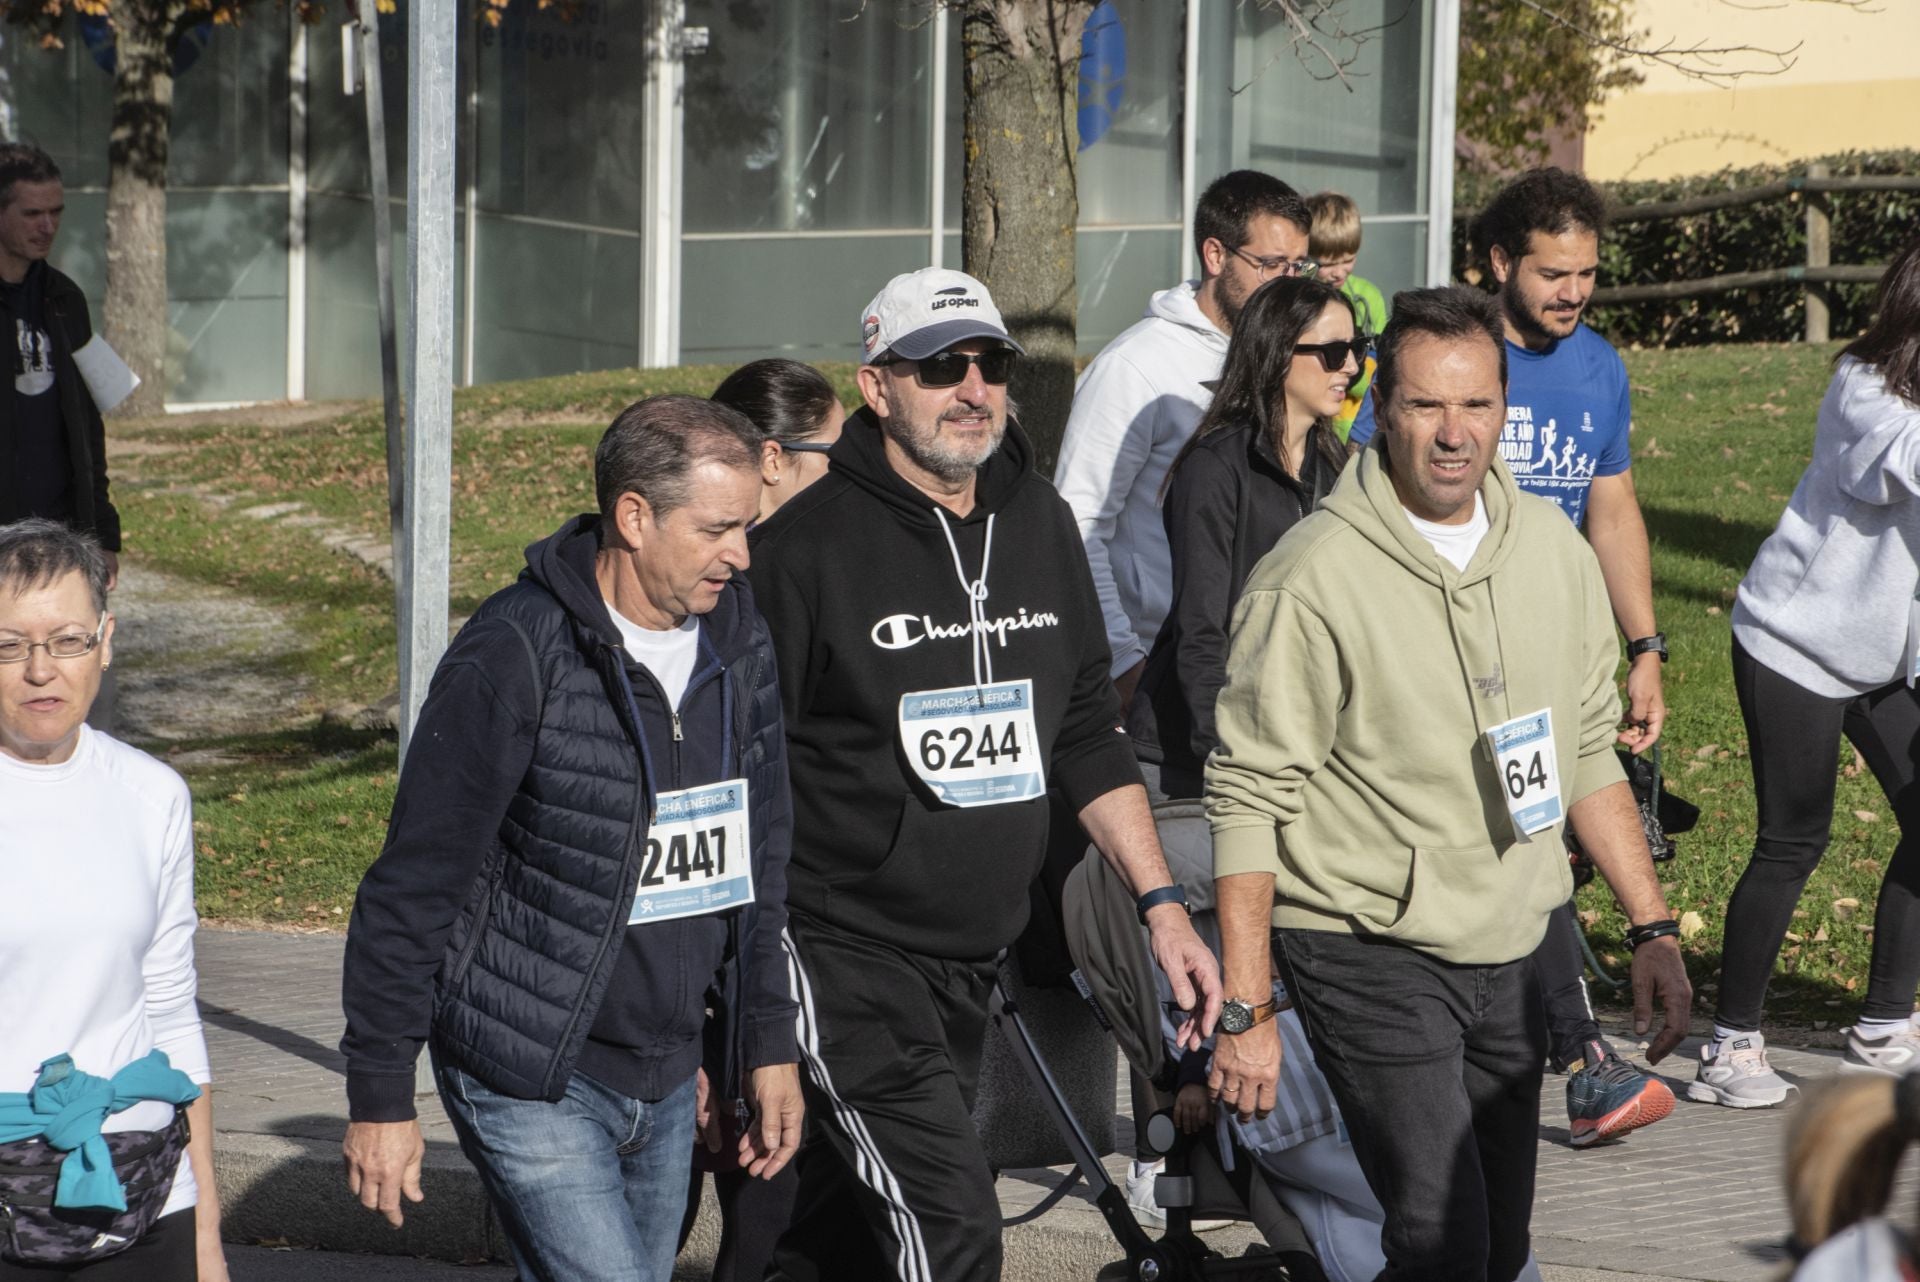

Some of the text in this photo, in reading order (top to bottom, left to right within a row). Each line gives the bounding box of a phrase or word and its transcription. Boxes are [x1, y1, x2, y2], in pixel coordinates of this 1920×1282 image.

[931, 296, 979, 311] us open
[921, 696, 970, 710] MARCHA
[919, 721, 1021, 772] 6244
[1505, 750, 1548, 799] 64
[640, 825, 726, 888] 2447
